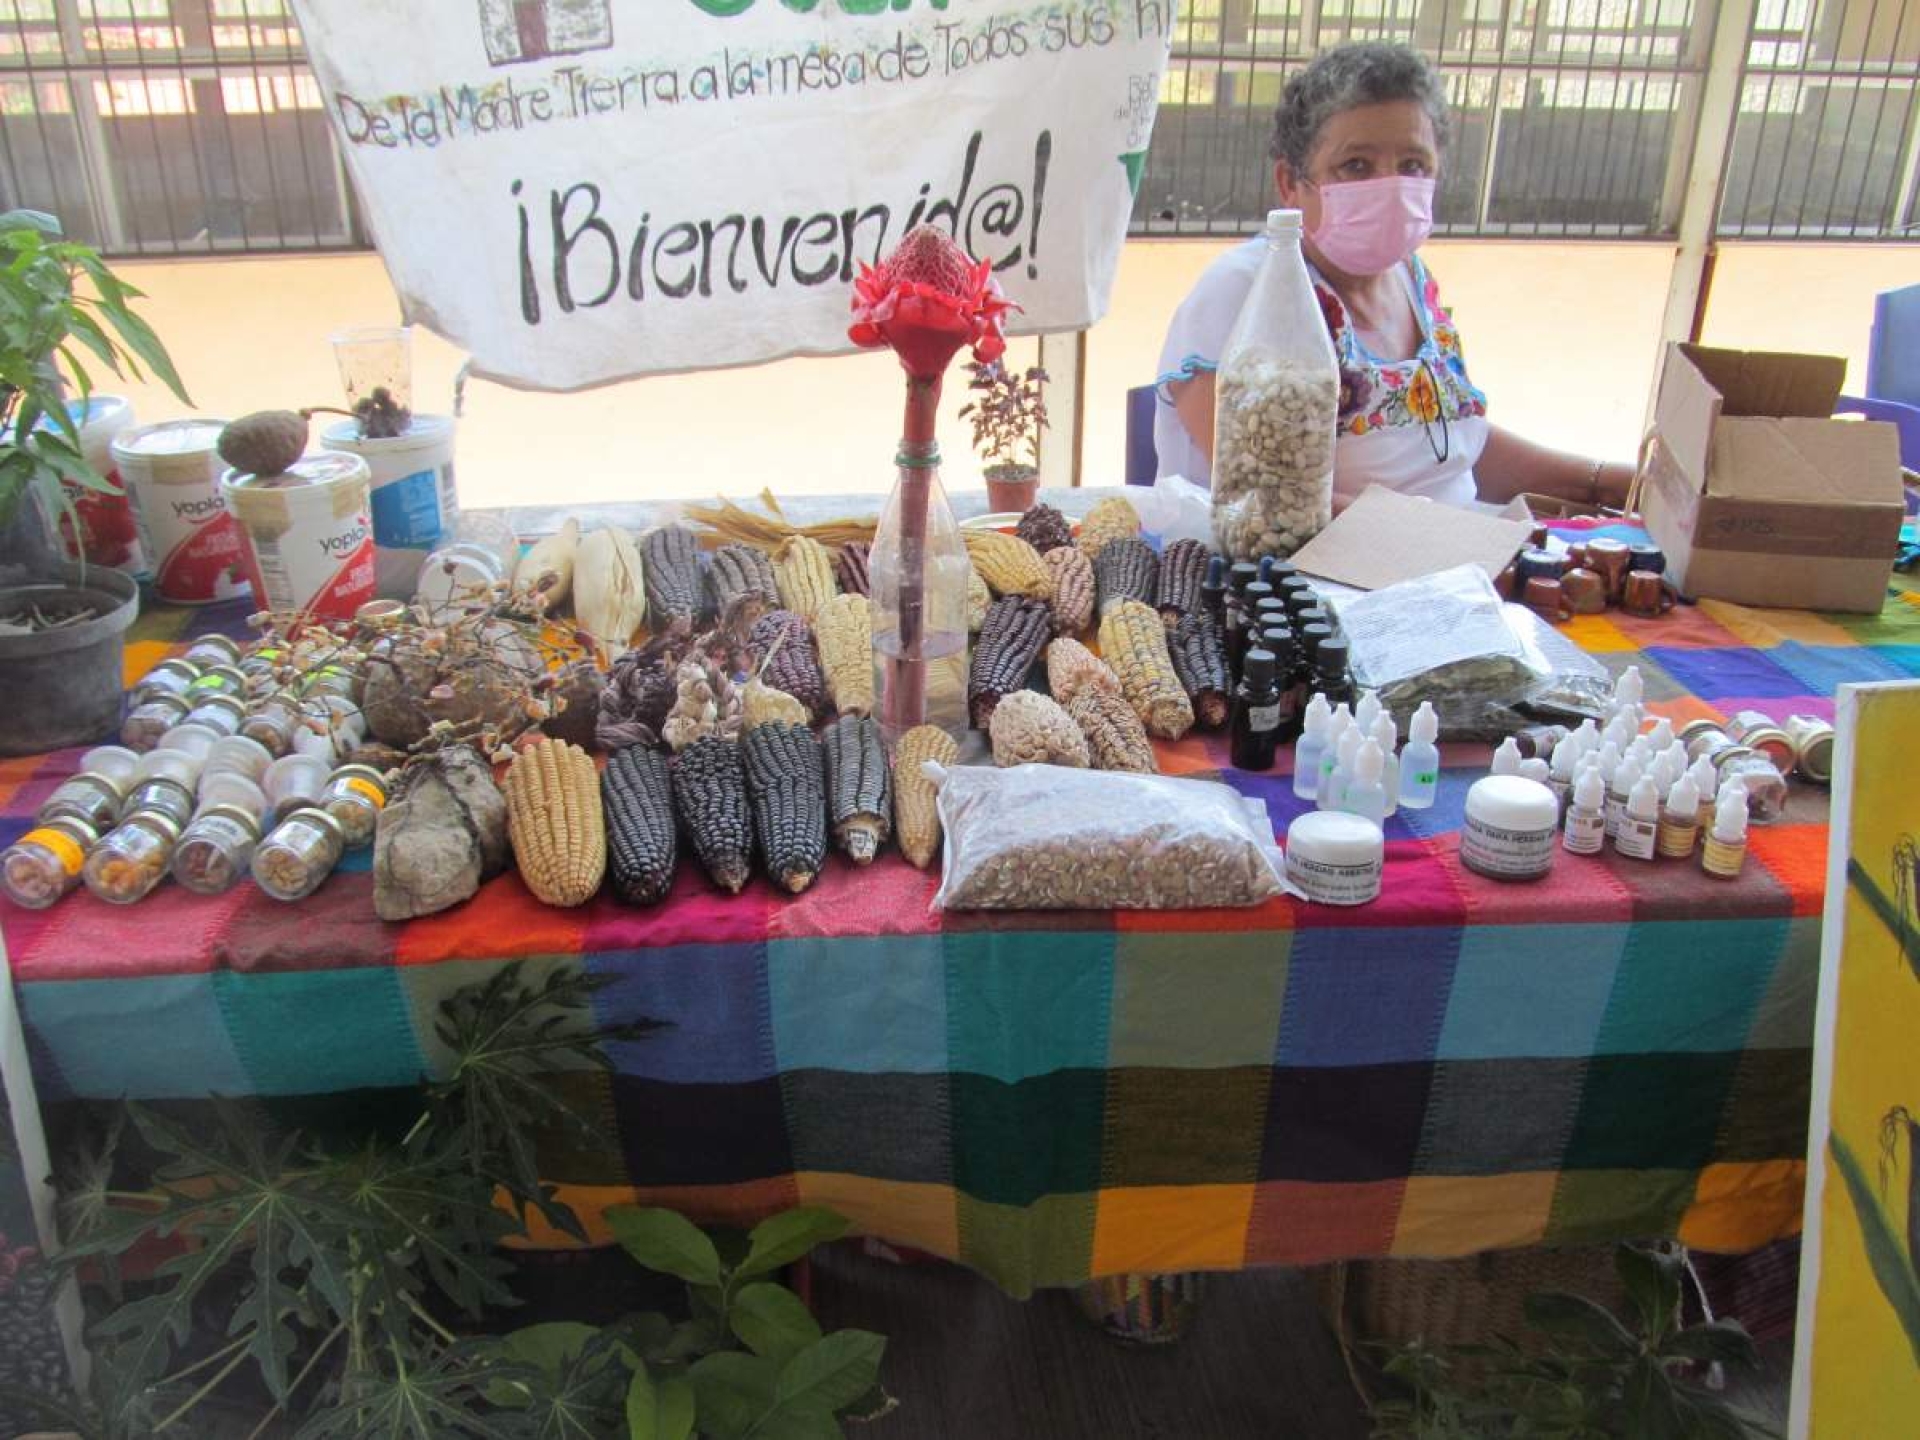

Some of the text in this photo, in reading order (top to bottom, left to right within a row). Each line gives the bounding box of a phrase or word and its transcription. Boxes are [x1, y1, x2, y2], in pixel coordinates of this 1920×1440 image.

[335, 93, 398, 147] De
[439, 77, 552, 138] Madre
[552, 65, 682, 117] Tierra
[875, 30, 931, 87] de
[934, 16, 1028, 77] Todos
